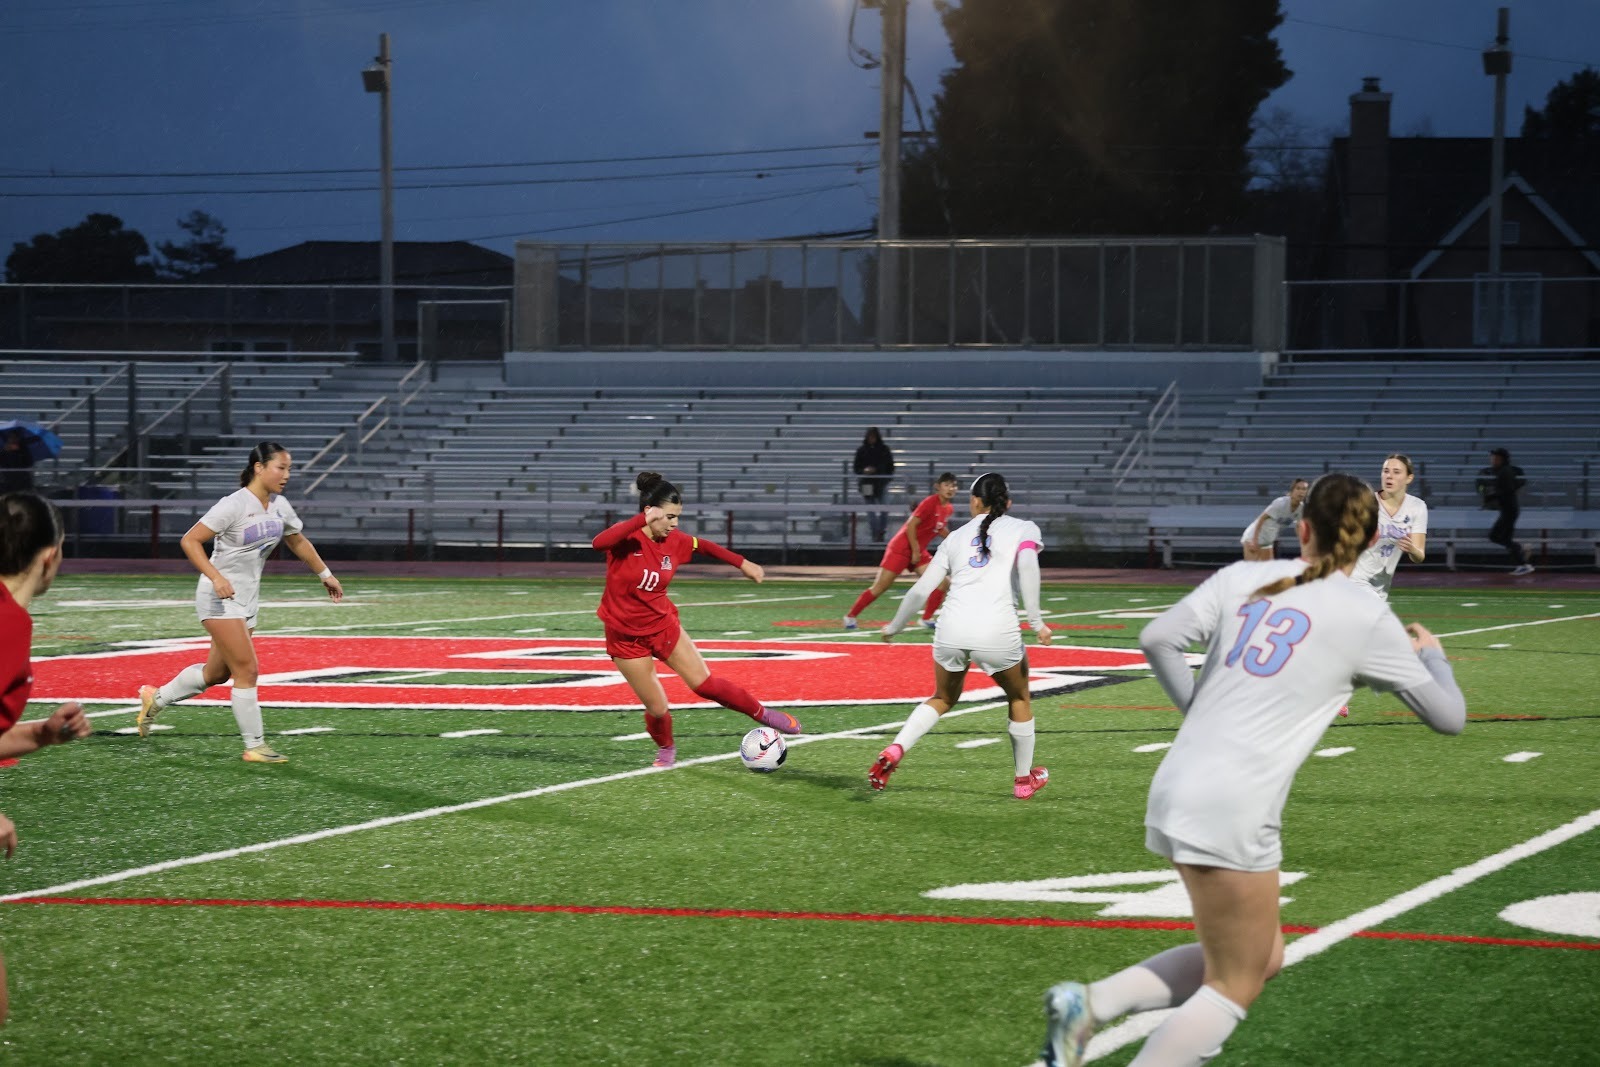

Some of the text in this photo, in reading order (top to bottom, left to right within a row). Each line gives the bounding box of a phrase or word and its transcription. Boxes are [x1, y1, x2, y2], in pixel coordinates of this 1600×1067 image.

[969, 534, 993, 568] 3
[636, 568, 660, 592] 10
[1224, 597, 1312, 678] 13
